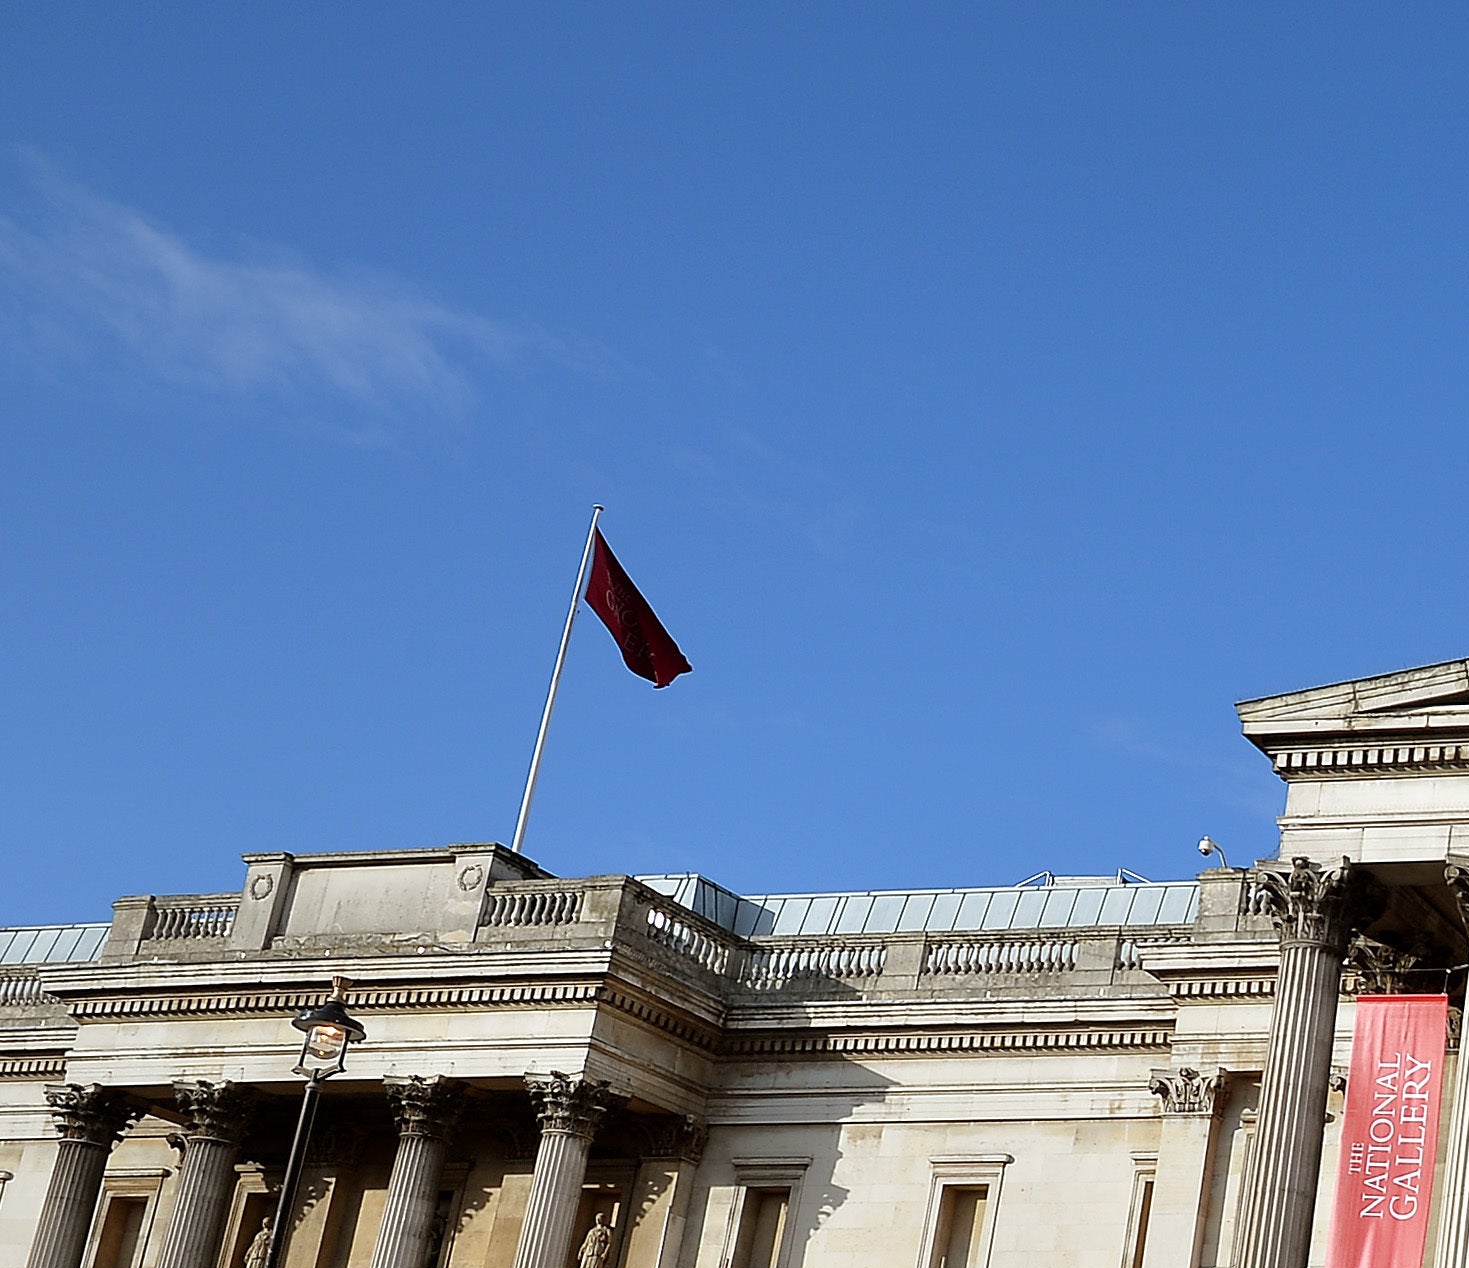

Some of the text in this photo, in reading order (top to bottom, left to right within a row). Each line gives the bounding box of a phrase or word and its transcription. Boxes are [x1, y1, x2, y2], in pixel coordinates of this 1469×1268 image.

[1348, 1142, 1365, 1175] THE
[1359, 1052, 1401, 1219] NATIONAL
[1389, 1053, 1432, 1221] GALLERY
